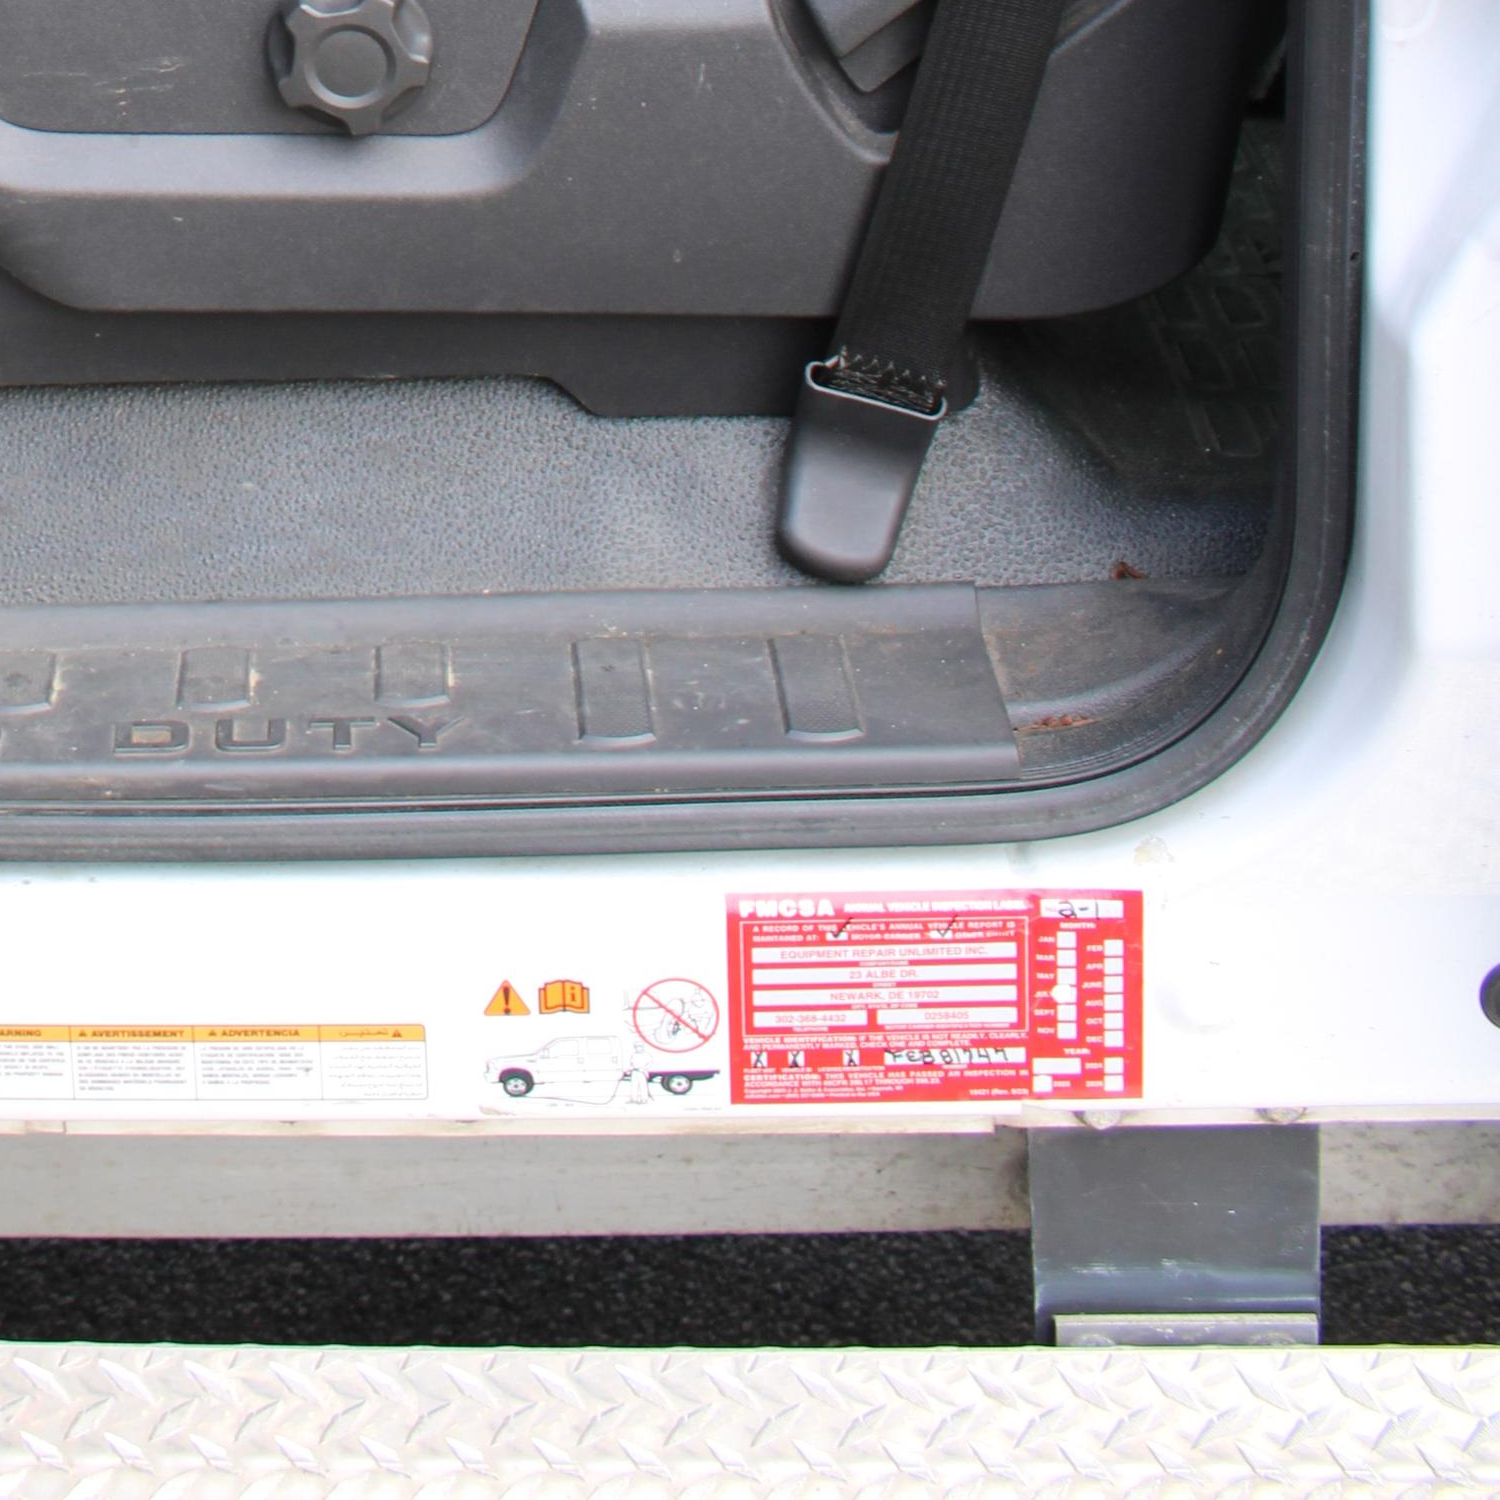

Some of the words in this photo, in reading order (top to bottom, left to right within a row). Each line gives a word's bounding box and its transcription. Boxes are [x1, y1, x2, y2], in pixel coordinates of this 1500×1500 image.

[113, 713, 468, 756] DUTY
[738, 898, 836, 917] FMCSA
[802, 924, 814, 932] OF
[889, 922, 923, 930] ANNUAL
[968, 921, 1002, 929] REPORT
[753, 934, 803, 942] MAINTAINED
[851, 933, 880, 941] MOTOR
[780, 949, 849, 959] EQUIPMENT
[852, 948, 896, 958] REPAIR
[899, 947, 962, 957] UNLIMITED
[964, 946, 988, 956] INC.
[849, 971, 863, 979] 23
[866, 970, 897, 978] ALBE
[830, 991, 885, 1001] NEWARK,
[888, 991, 905, 1000] DE
[908, 990, 940, 999] 19702
[91, 1030, 185, 1038] AVERTISSEMENT
[221, 1029, 300, 1038] ADVERTENCIA
[886, 1034, 921, 1042] VEHICLE
[888, 1071, 906, 1079] HAS
[910, 1070, 944, 1078] PASSED
[964, 1069, 1017, 1077] INSPECTION
